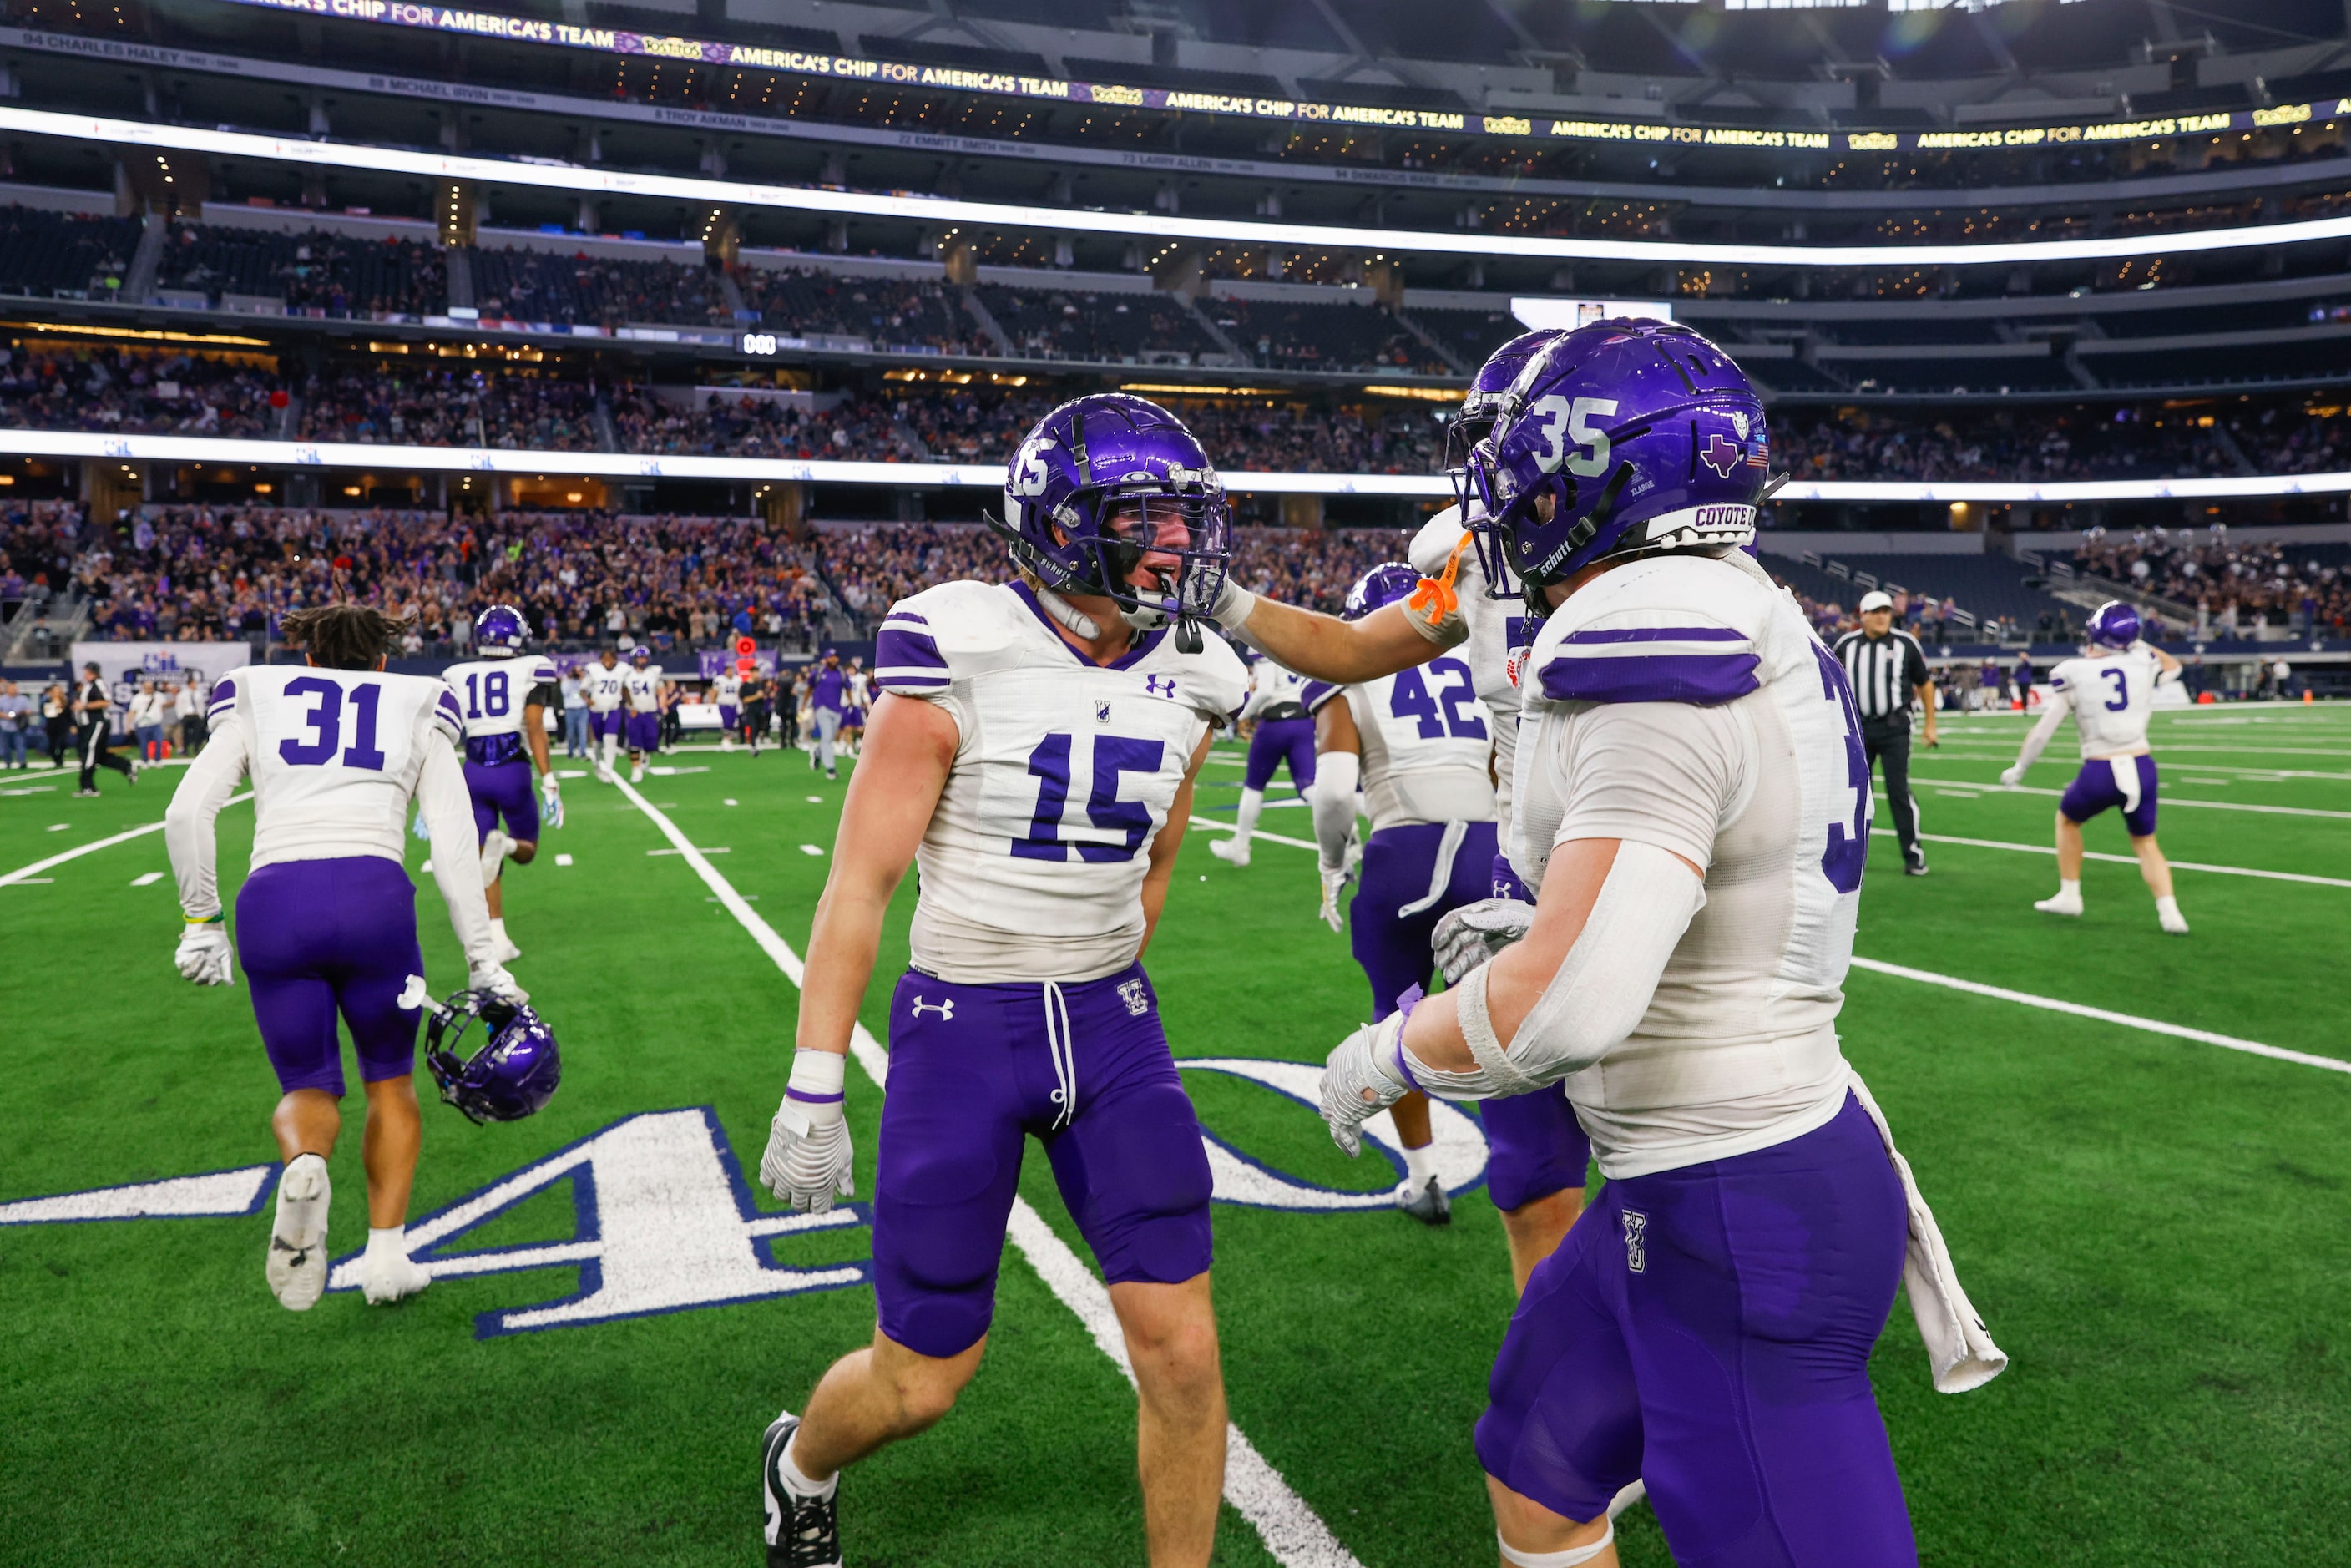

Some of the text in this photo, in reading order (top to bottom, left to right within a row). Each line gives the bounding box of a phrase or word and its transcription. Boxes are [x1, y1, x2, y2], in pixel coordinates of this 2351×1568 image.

[392, 3, 434, 26] FOR
[439, 10, 552, 40] AMERICA'S
[556, 25, 614, 48] TEAM
[23, 33, 43, 44] 94
[47, 35, 125, 56] CHARLES
[128, 47, 179, 63] HALEY
[389, 79, 448, 97] MICHAEL
[730, 46, 1069, 98] AMERICA'S CHIP FOR AMERICA'S TEAM
[665, 110, 697, 124] TROY
[700, 114, 746, 129] AIKMAN
[1165, 93, 1464, 129] AMERICA'S CHIP FOR AMERICA'S TEAM
[1917, 113, 2231, 148] AMERICA'S CHIP FOR AMERICA'S TEAM
[1551, 121, 1830, 149] AMERICA'S CHIP FOR AMERICA'S TEAM
[1530, 394, 1619, 478] 35
[1012, 438, 1058, 497] 15
[1630, 479, 1655, 498] XLARGE
[1696, 506, 1747, 528] COYOTE
[1540, 539, 1574, 578] schutt
[466, 670, 509, 719] 18
[600, 680, 618, 694] 70
[1389, 657, 1488, 741] 42
[2101, 668, 2128, 711] 3
[279, 676, 385, 771] 31
[1010, 733, 1165, 862] 15
